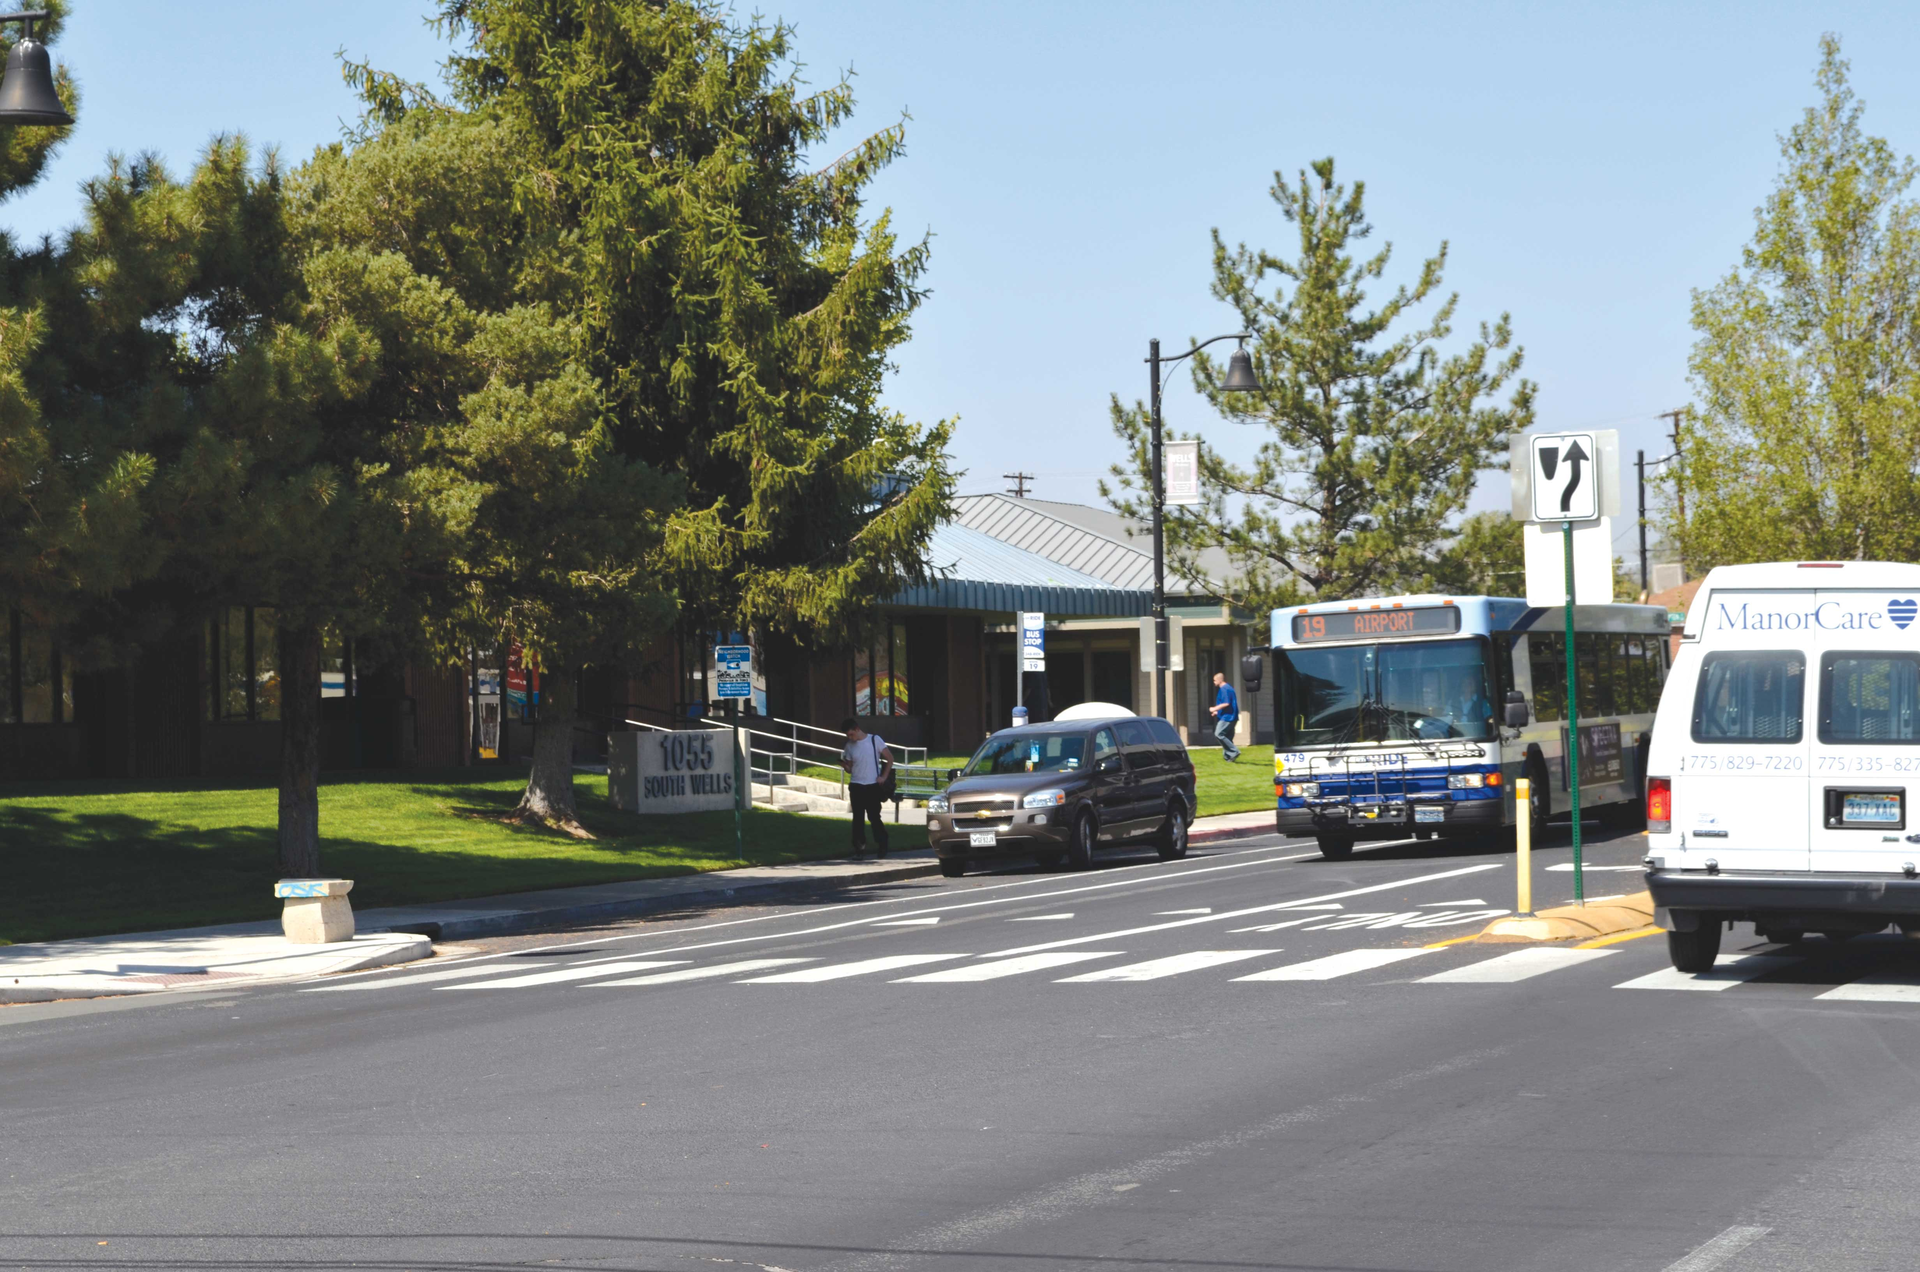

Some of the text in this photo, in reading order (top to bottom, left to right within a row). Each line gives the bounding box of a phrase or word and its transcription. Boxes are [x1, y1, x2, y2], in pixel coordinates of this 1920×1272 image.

[1302, 611, 1415, 638] 19 AIRPORT
[1716, 601, 1882, 631] ManorCare
[660, 733, 714, 772] 1055
[1283, 753, 1305, 764] 479
[1690, 755, 1803, 772] 775/829-7220
[644, 772, 732, 799] SOUTH WELLS
